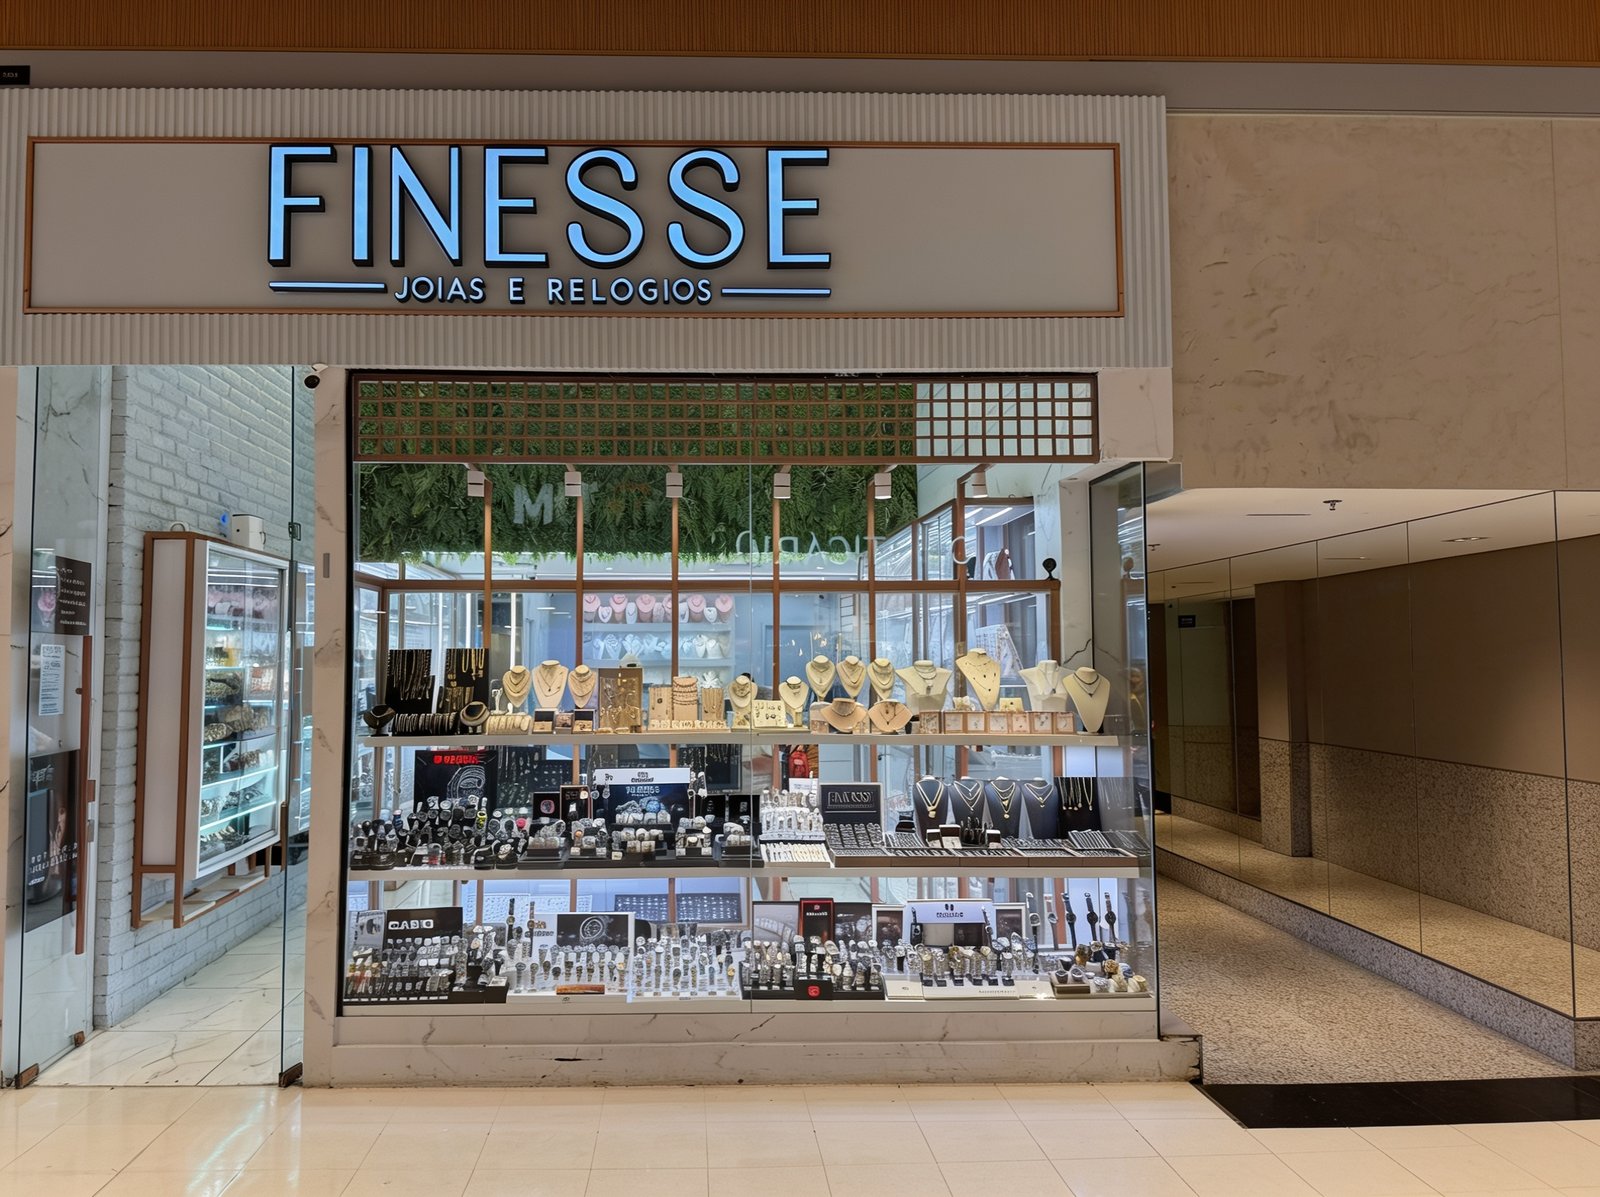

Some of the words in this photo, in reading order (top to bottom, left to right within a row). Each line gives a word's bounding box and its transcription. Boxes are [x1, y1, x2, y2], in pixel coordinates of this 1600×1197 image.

[268, 144, 831, 270] FINESSE
[394, 276, 486, 304] JOIAS
[508, 277, 526, 304] E
[547, 277, 713, 305] RELOGIOS
